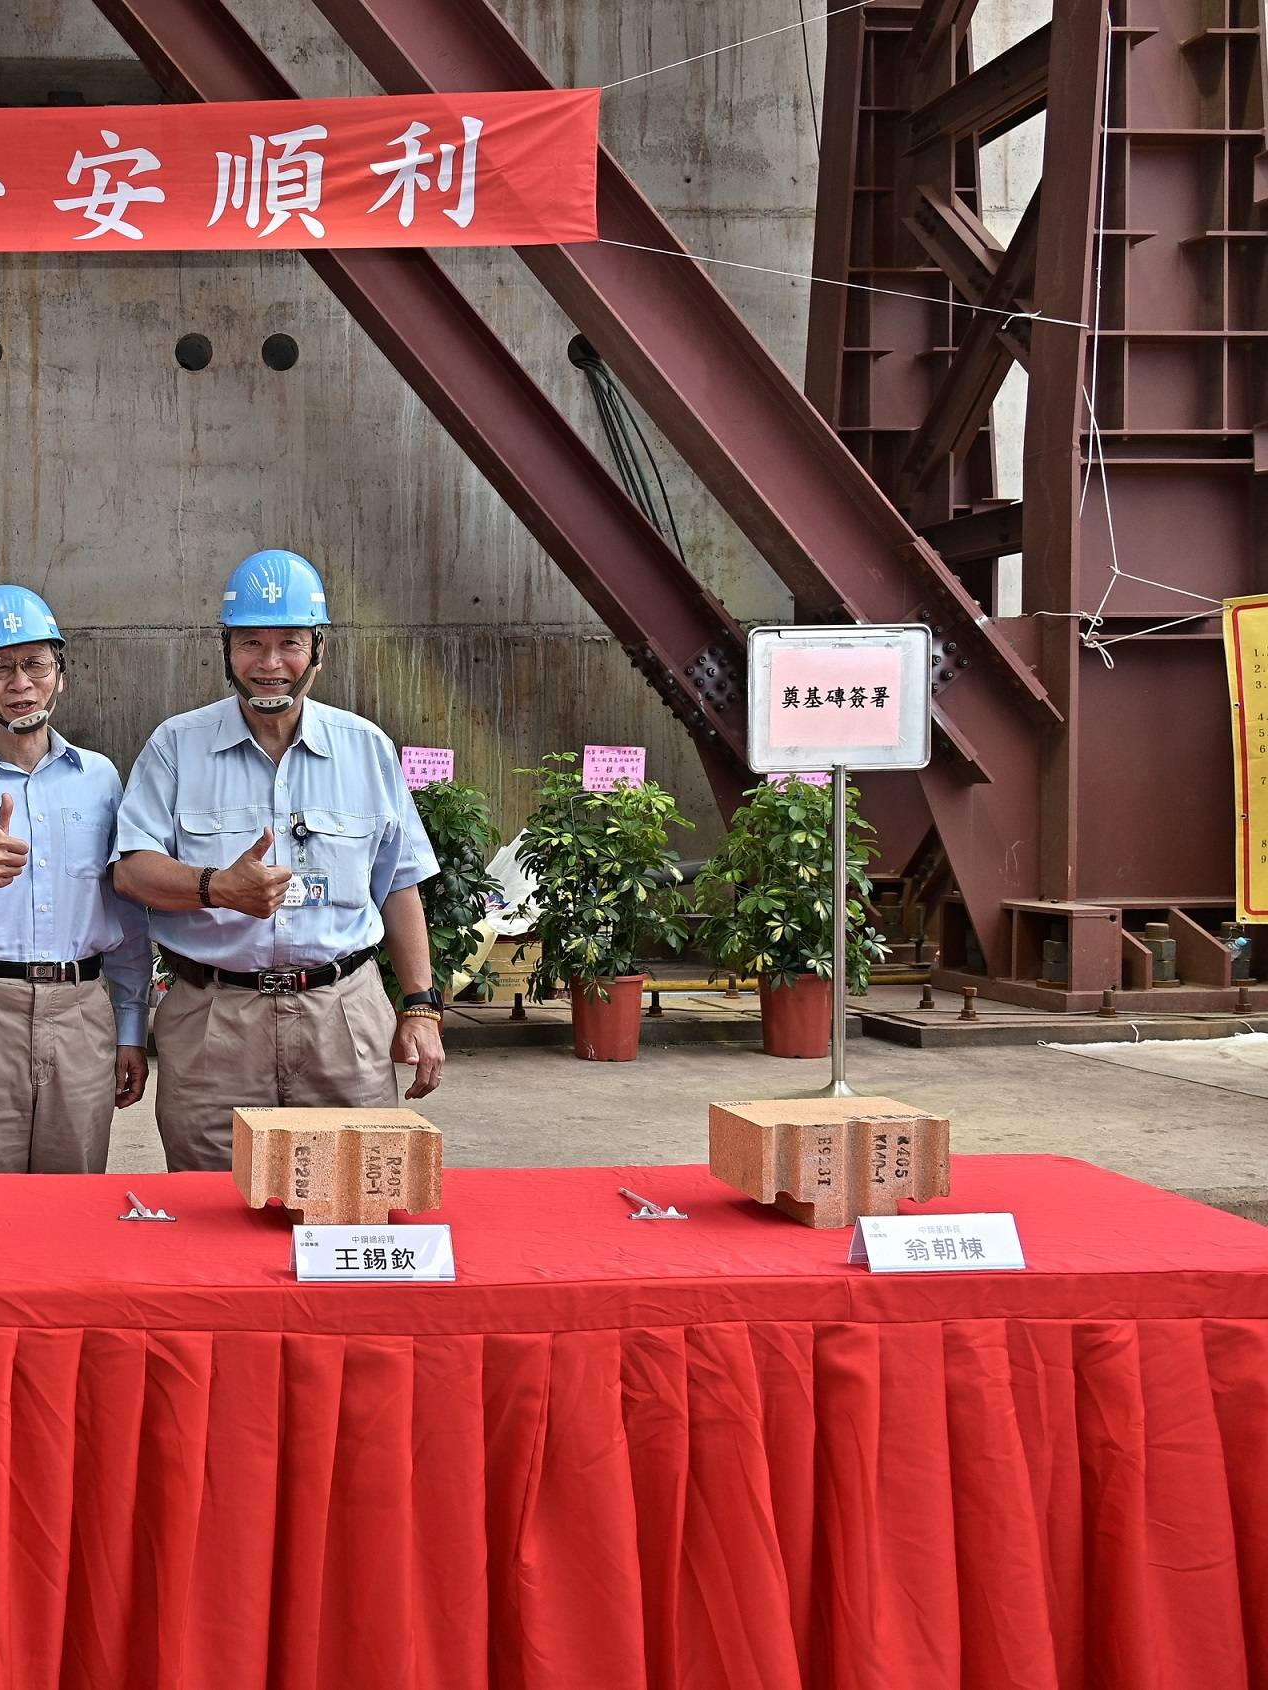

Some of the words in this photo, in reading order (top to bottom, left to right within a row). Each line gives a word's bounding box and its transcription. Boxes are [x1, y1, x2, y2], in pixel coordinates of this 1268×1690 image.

[781, 685, 891, 709] 奠基磚簽署
[351, 1235, 396, 1245] 中鋼總經理
[903, 1237, 986, 1262] 翁朝棟
[334, 1247, 417, 1271] 王錫欽
